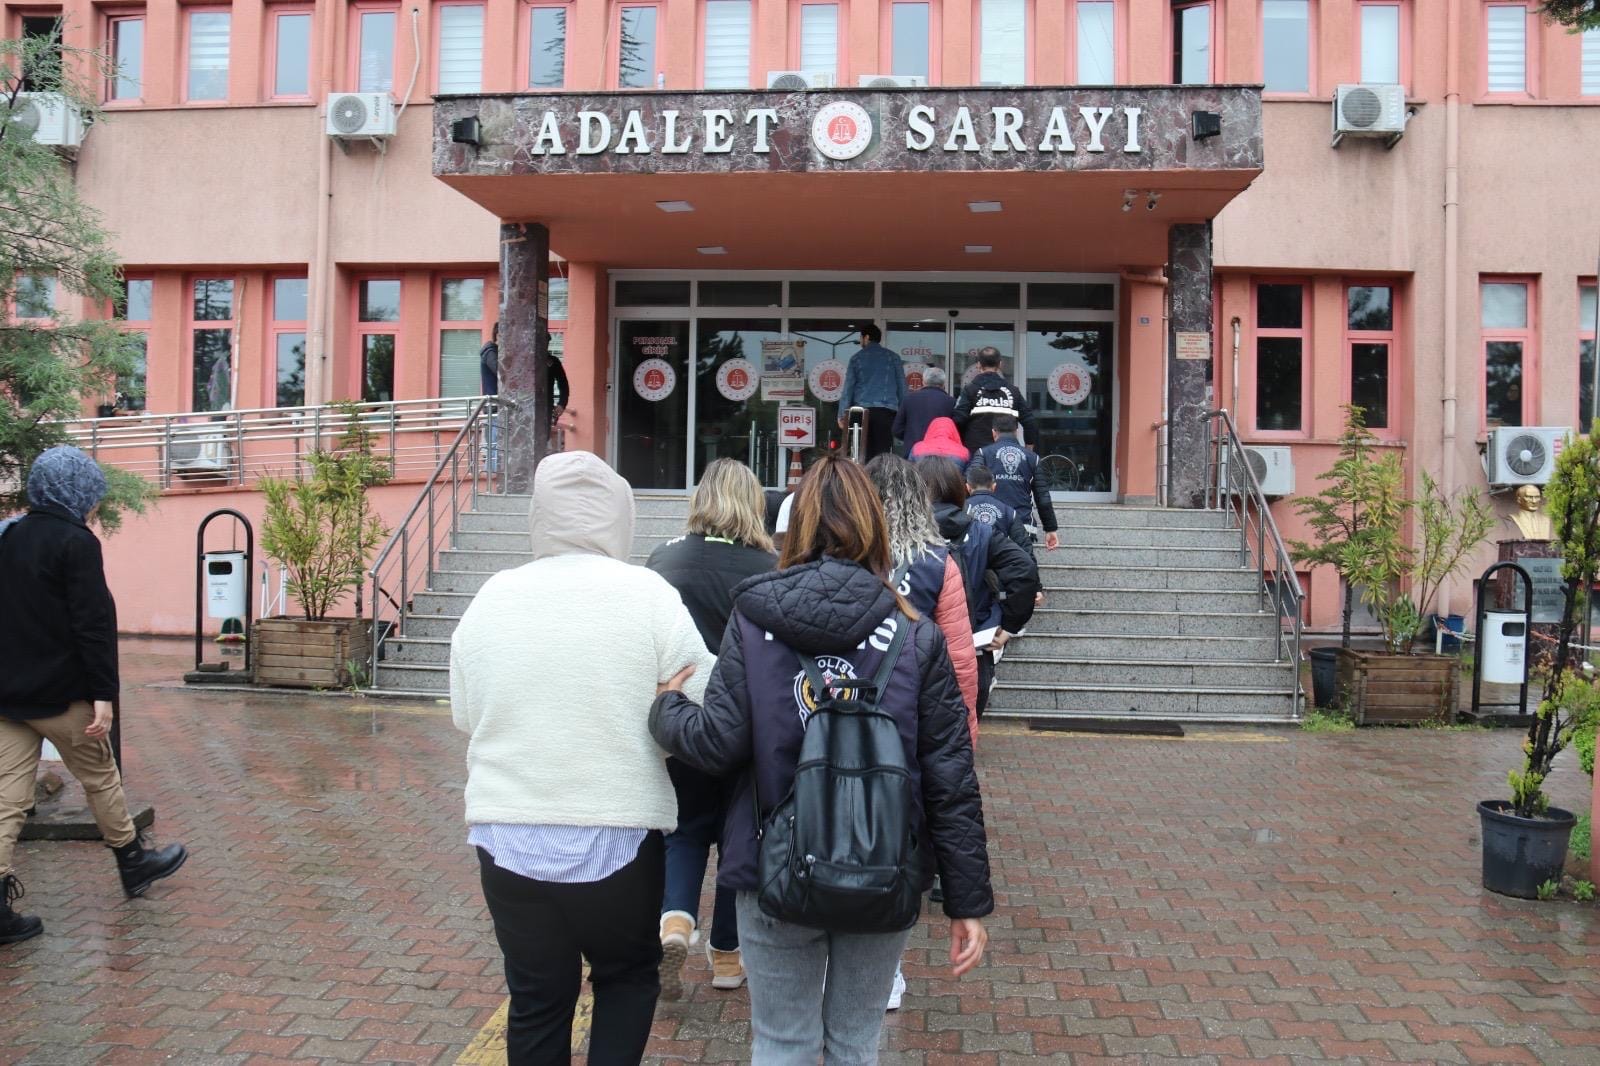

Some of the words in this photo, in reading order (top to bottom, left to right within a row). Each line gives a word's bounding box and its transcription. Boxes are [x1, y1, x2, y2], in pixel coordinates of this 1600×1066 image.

[531, 108, 779, 154] ADALET
[906, 104, 1141, 153] SARAYI
[782, 414, 812, 426] GİRİŞ
[817, 658, 848, 674] OLİS
